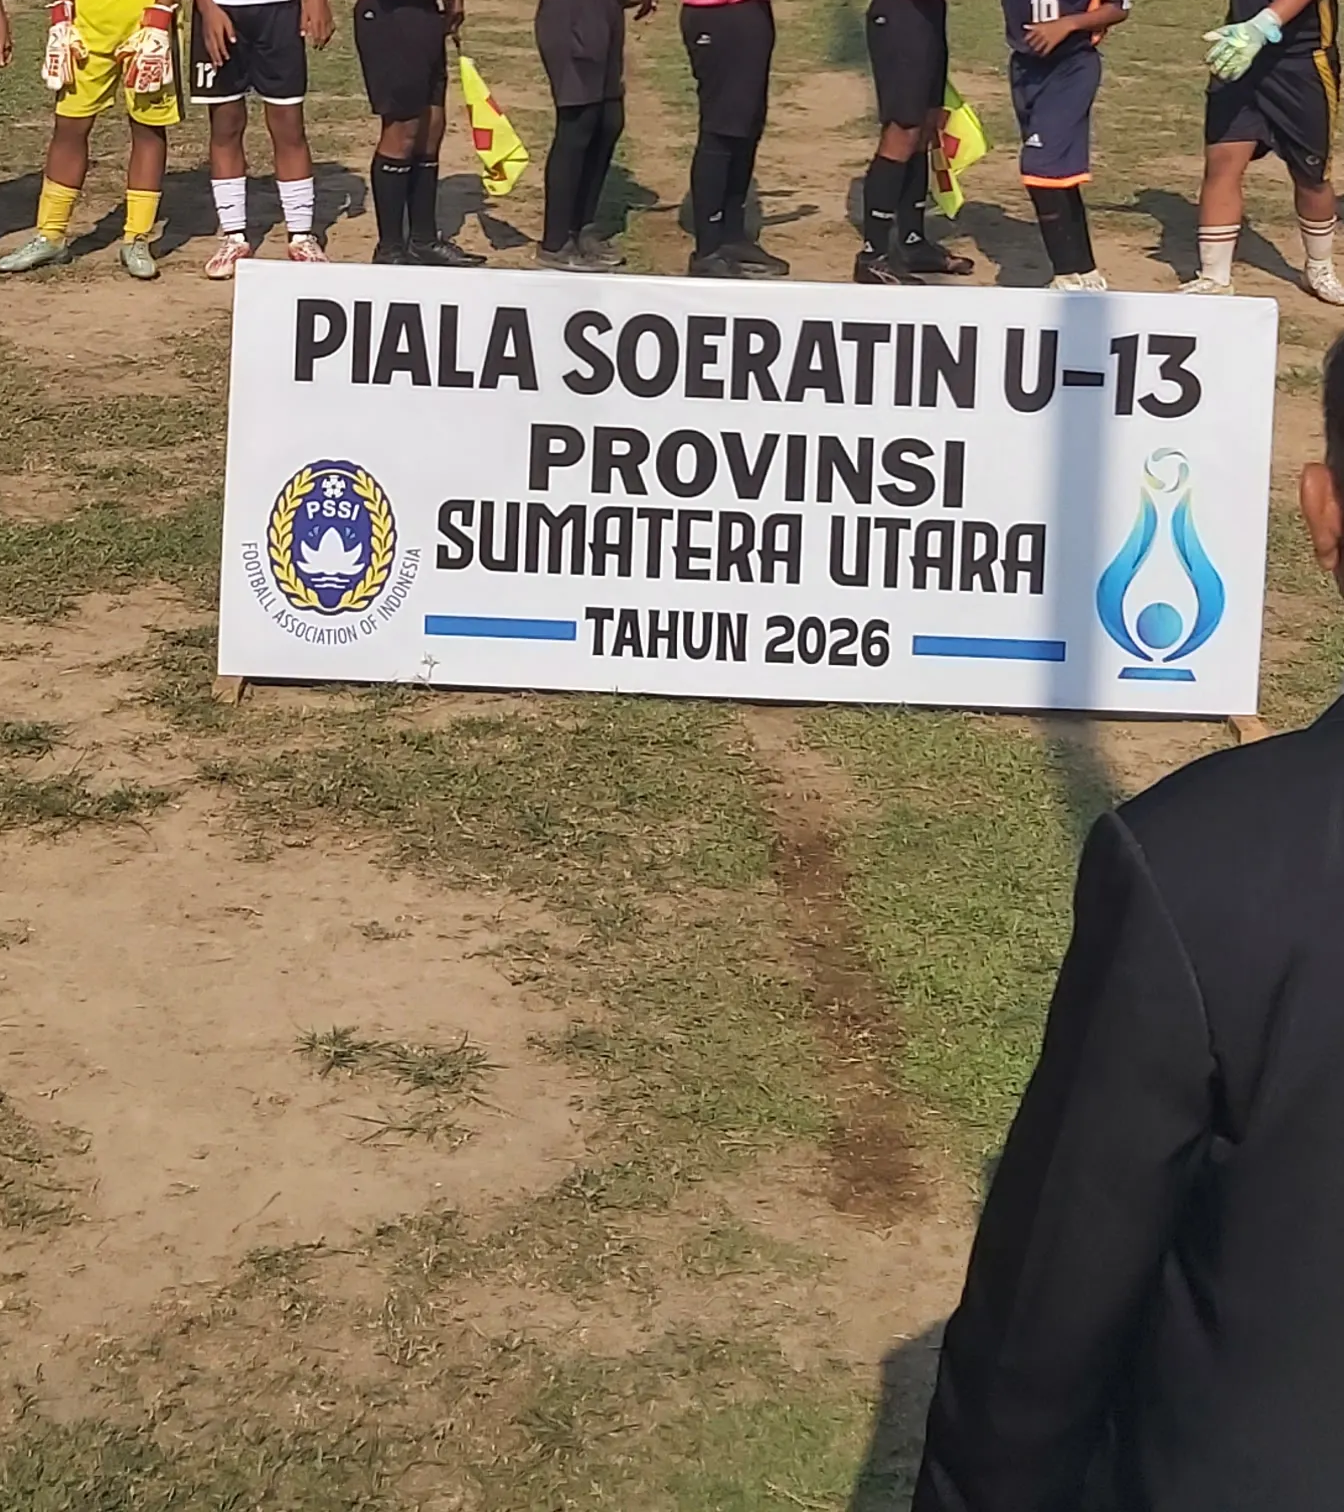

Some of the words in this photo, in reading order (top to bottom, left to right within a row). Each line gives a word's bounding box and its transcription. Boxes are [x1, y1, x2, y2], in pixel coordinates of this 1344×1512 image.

[295, 299, 539, 391] PIALA
[563, 311, 978, 409] SOERATIN
[1005, 329, 1202, 419] U-13
[306, 499, 360, 521] PSSI
[529, 424, 965, 508] PROVINSI
[437, 500, 803, 585] SUMATERA
[830, 516, 1047, 595] UTARA
[242, 542, 276, 612] FOOTBALL
[272, 608, 359, 646] ASSOCIATION
[360, 614, 379, 635] OF
[377, 548, 422, 621] INDONESIA
[586, 607, 748, 662] TAHUN
[765, 616, 890, 667] 2026
